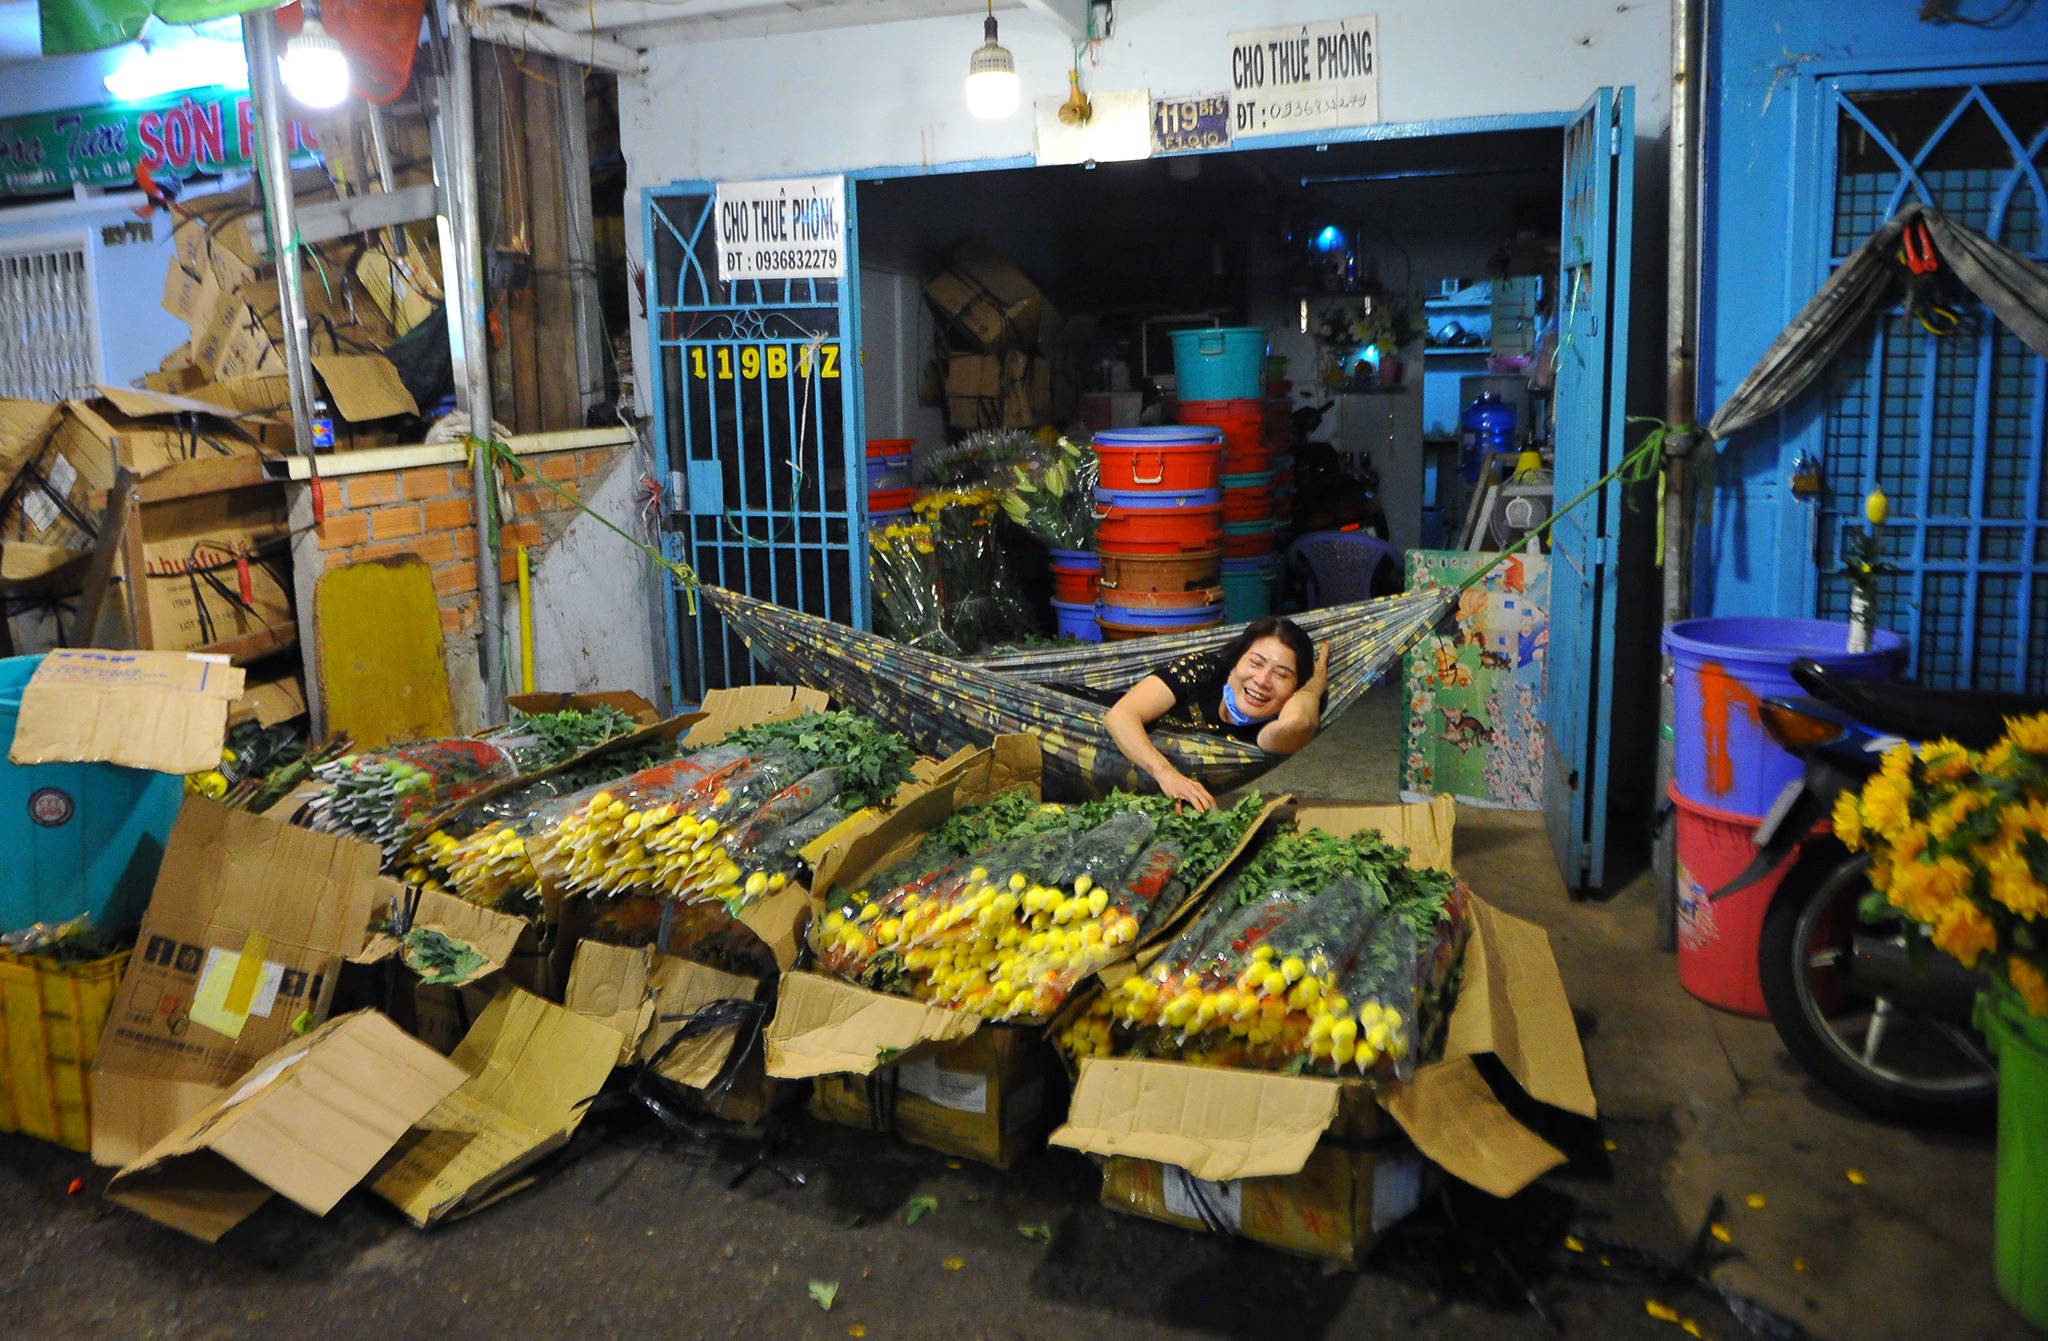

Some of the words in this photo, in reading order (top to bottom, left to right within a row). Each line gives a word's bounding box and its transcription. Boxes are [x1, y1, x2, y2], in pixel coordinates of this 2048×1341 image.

[1232, 41, 1264, 90] CHO
[1268, 26, 1310, 86] THUÊ
[1317, 21, 1373, 80] PHÒNG
[138, 95, 225, 171] SƠN
[723, 200, 749, 244] CHO
[752, 187, 788, 243] THUÊ
[792, 186, 838, 241] PHÒNG
[756, 249, 837, 270] 0936832279
